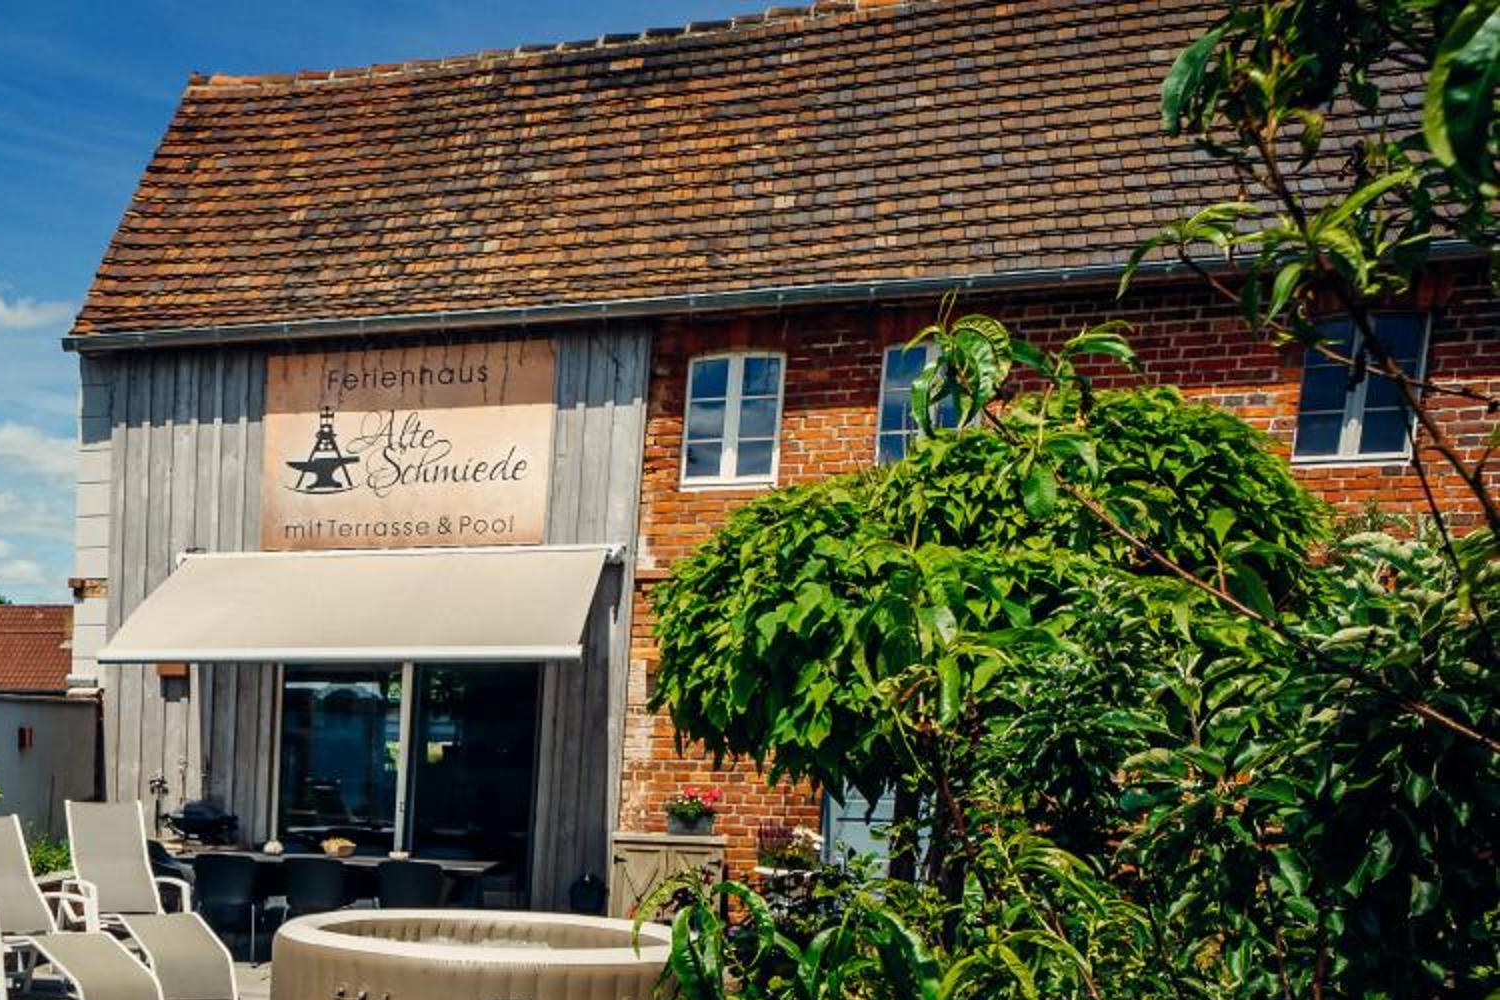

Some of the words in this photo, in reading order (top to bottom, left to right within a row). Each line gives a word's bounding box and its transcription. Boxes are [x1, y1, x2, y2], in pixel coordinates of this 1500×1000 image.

[327, 364, 489, 390] Ferienhaus
[346, 408, 453, 460] Alte
[365, 445, 528, 498] Schmiede
[284, 519, 321, 539] mit
[327, 518, 430, 538] Terrasse
[436, 517, 453, 535] &
[458, 514, 514, 534] Pool
